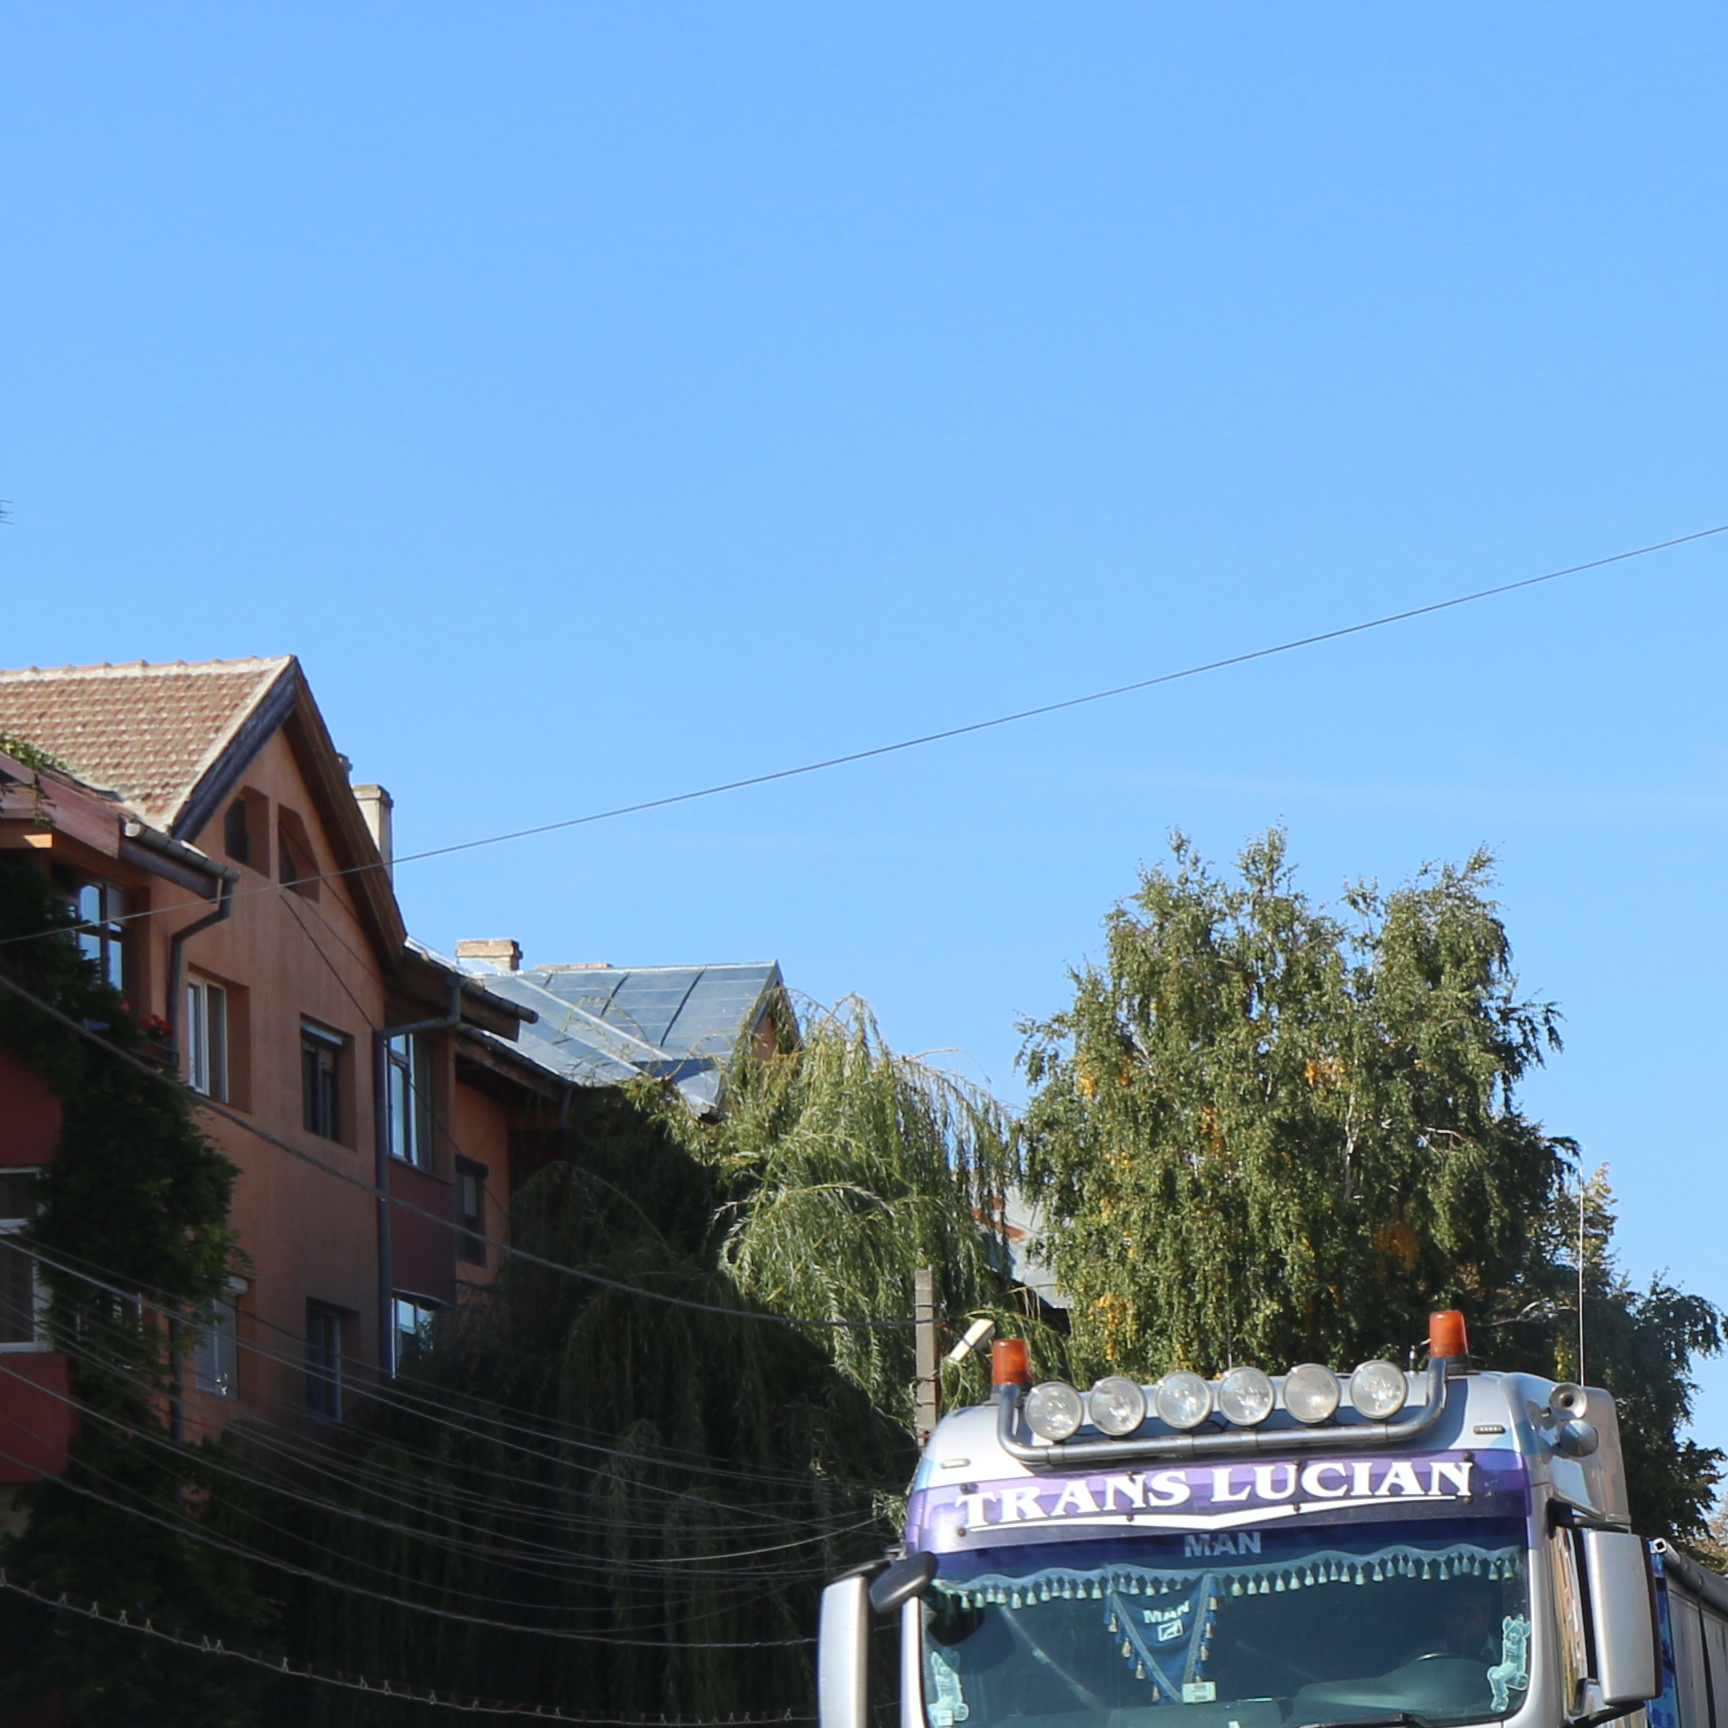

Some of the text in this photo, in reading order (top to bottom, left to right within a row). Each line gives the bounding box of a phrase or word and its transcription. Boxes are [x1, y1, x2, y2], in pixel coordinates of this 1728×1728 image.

[956, 1460, 1474, 1527] TRANS LUCIAN
[1184, 1531, 1262, 1557] MAN
[1143, 1600, 1191, 1624] MAN
